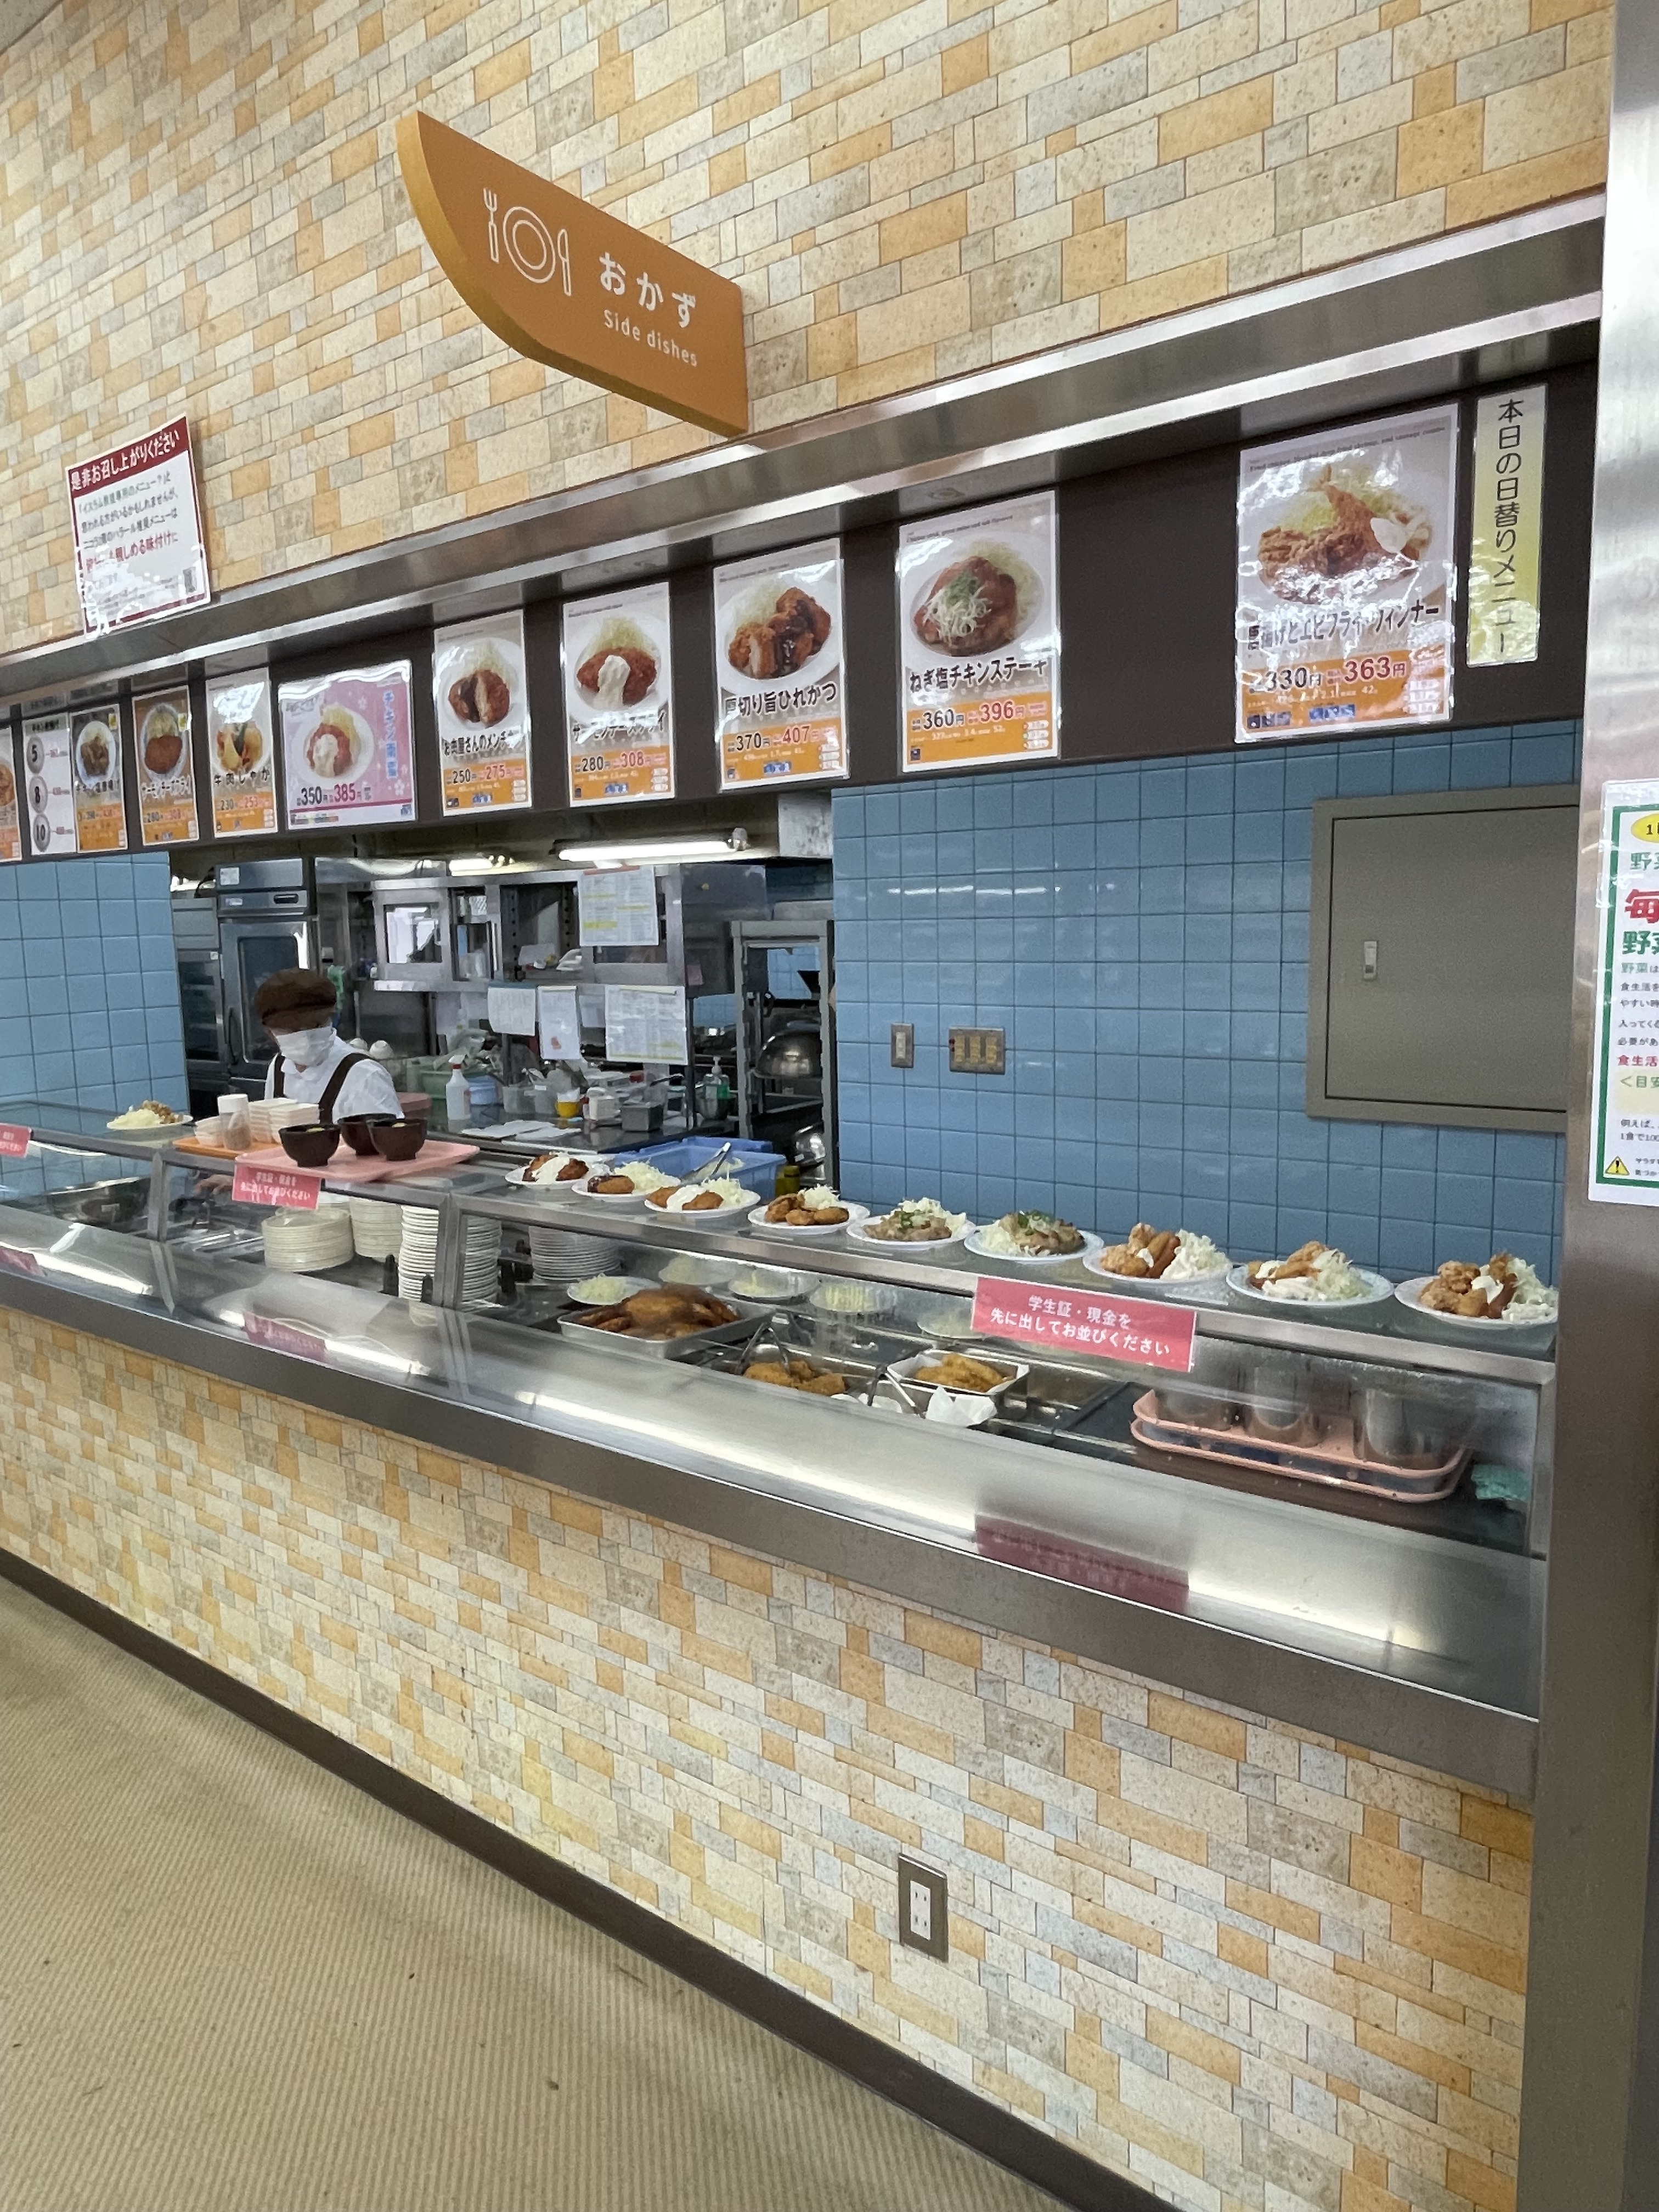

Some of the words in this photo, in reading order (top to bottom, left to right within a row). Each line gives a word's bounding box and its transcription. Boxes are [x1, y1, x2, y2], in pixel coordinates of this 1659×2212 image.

[599, 251, 696, 328] おかず
[604, 309, 640, 341] Side
[647, 330, 697, 367] dishes
[71, 430, 180, 491] 是非お召し上がりください
[1492, 398, 1524, 653] 本日の日替りメニュー
[1344, 656, 1406, 682] 363円
[990, 1307, 1170, 1355] 先に出してお並びください
[1028, 1294, 1131, 1330] 学生証・現金を
